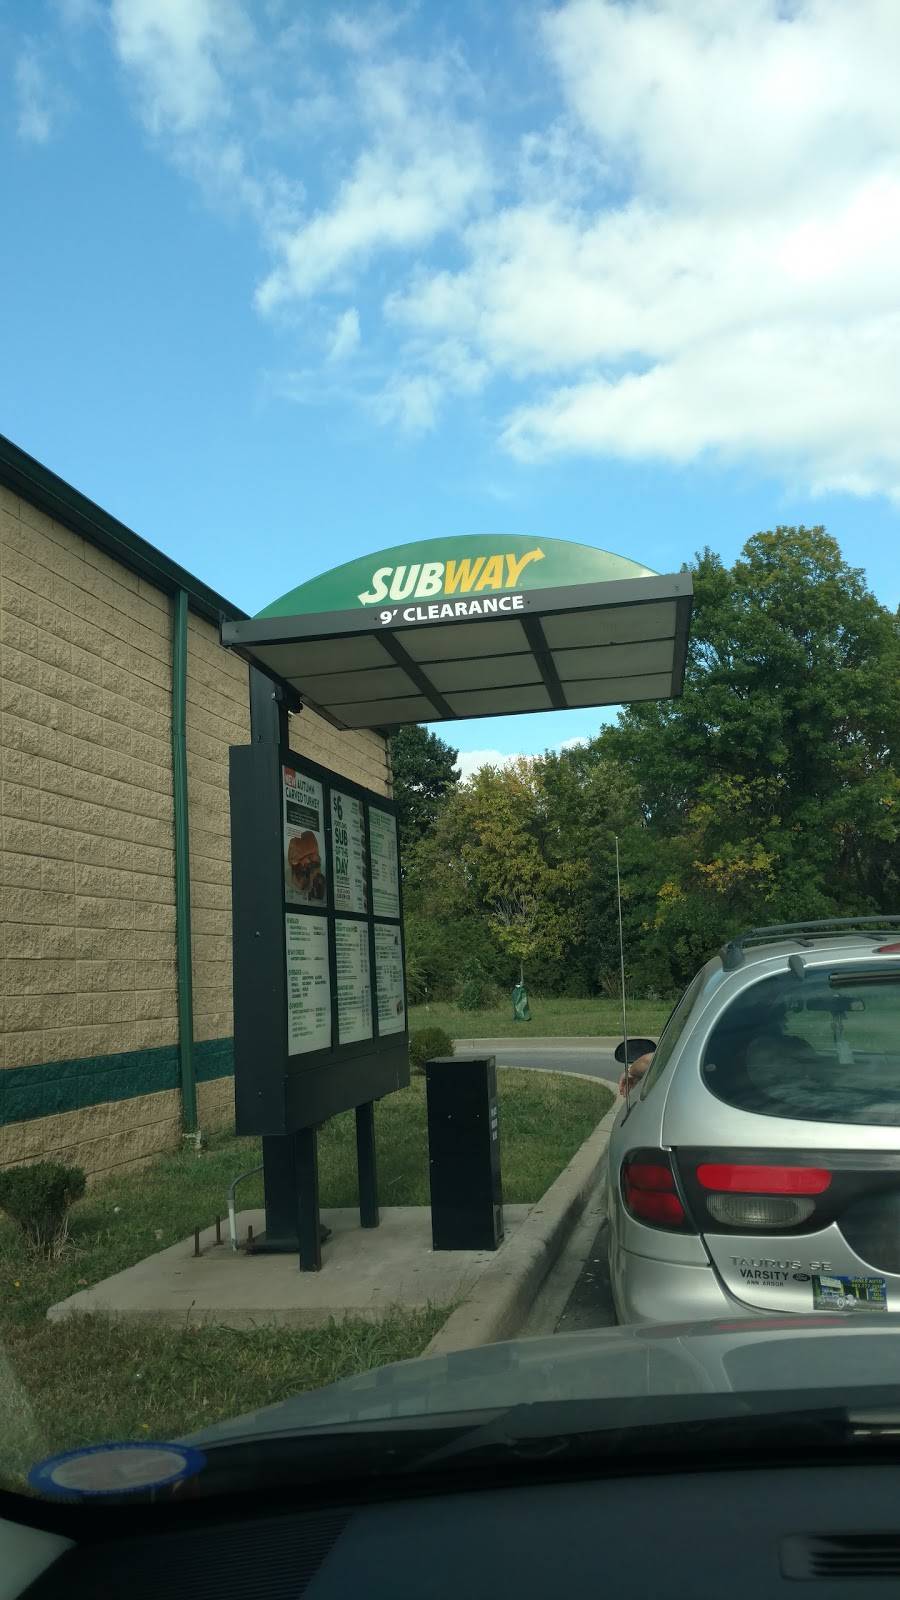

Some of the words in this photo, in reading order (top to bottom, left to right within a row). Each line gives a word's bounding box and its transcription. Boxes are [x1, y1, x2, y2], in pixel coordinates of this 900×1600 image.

[358, 548, 545, 606] SUBWAY
[403, 595, 524, 622] CLEARANCE
[335, 828, 348, 847] SUB
[336, 856, 349, 875] DAY
[729, 1256, 802, 1270] TAURUS
[809, 1261, 833, 1271] SE
[740, 1269, 789, 1281] VARSITY
